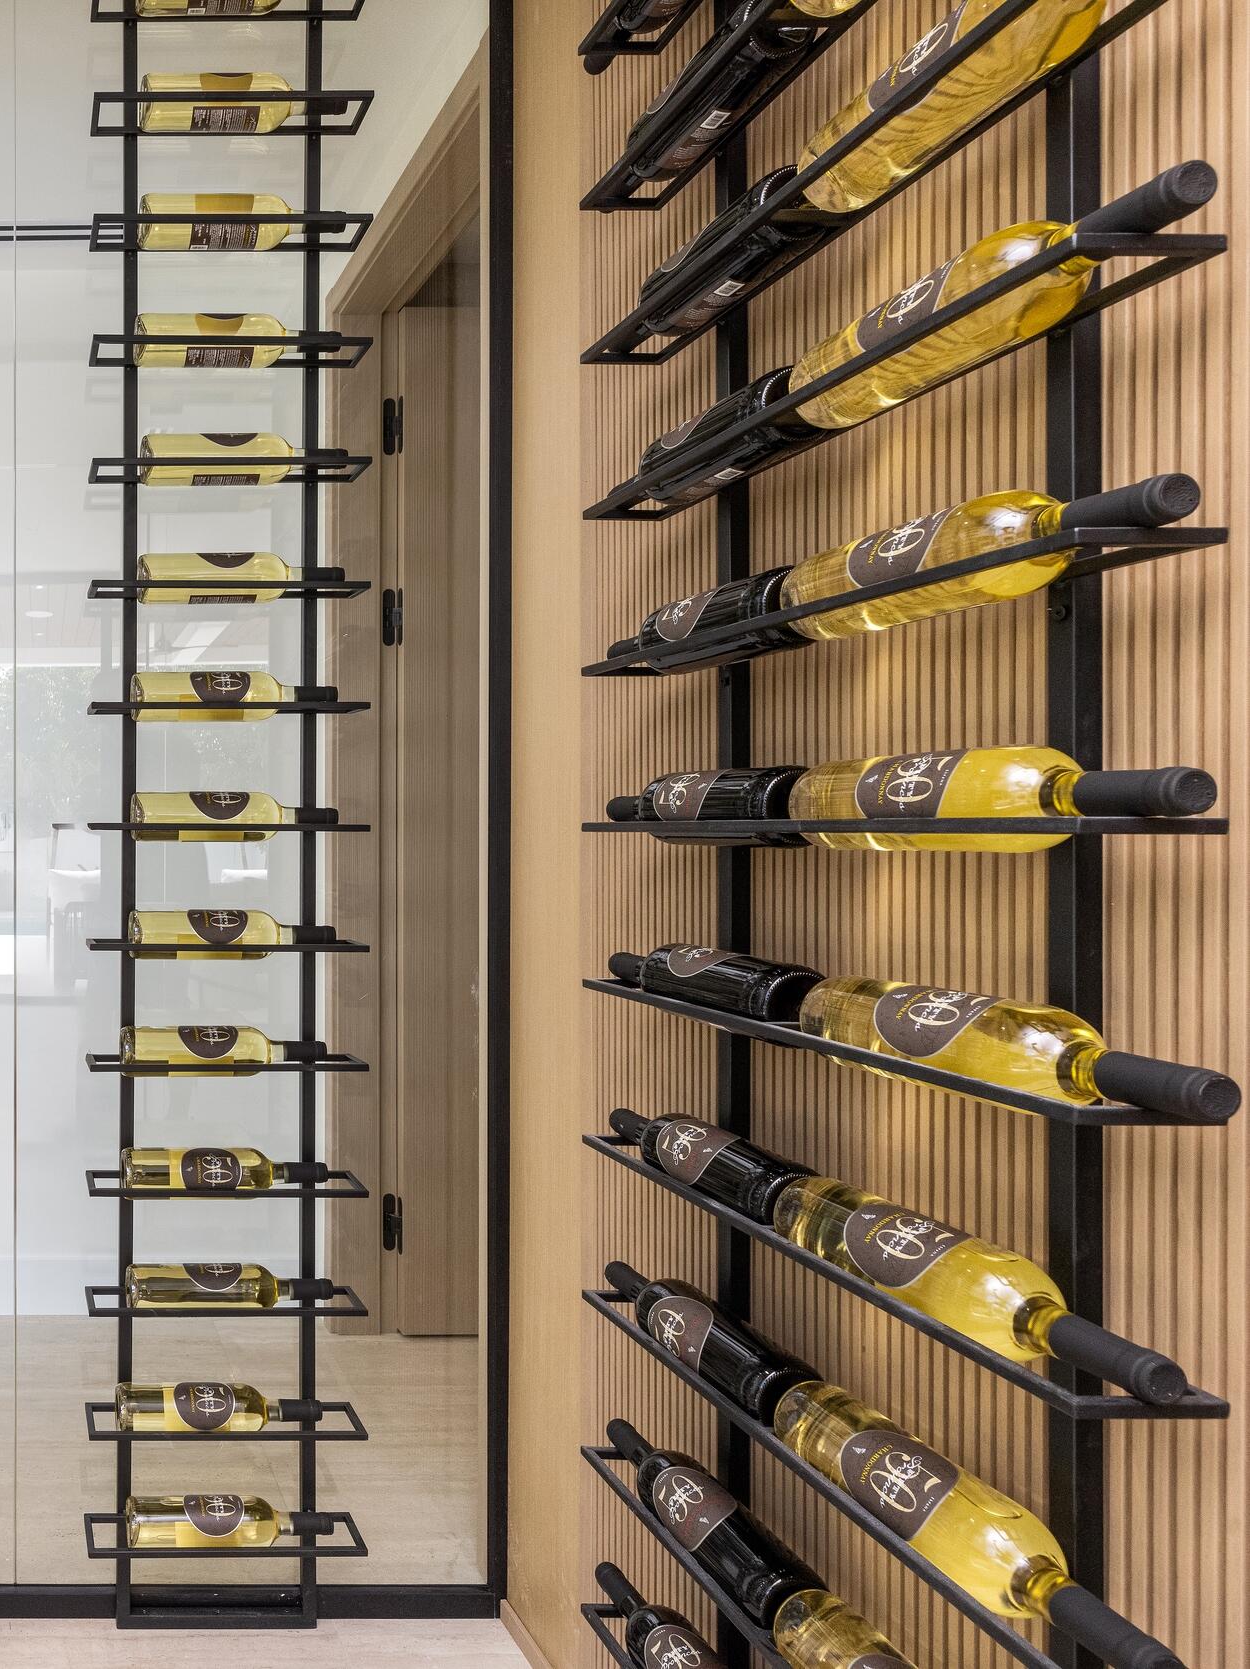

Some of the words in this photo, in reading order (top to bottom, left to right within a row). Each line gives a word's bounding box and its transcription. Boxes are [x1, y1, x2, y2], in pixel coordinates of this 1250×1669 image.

[886, 756, 953, 801] 50
[876, 1217, 953, 1259] 50
[860, 1443, 892, 1484] CHARDONNAY
[871, 1452, 941, 1511] 50
[658, 1475, 703, 1521] 50
